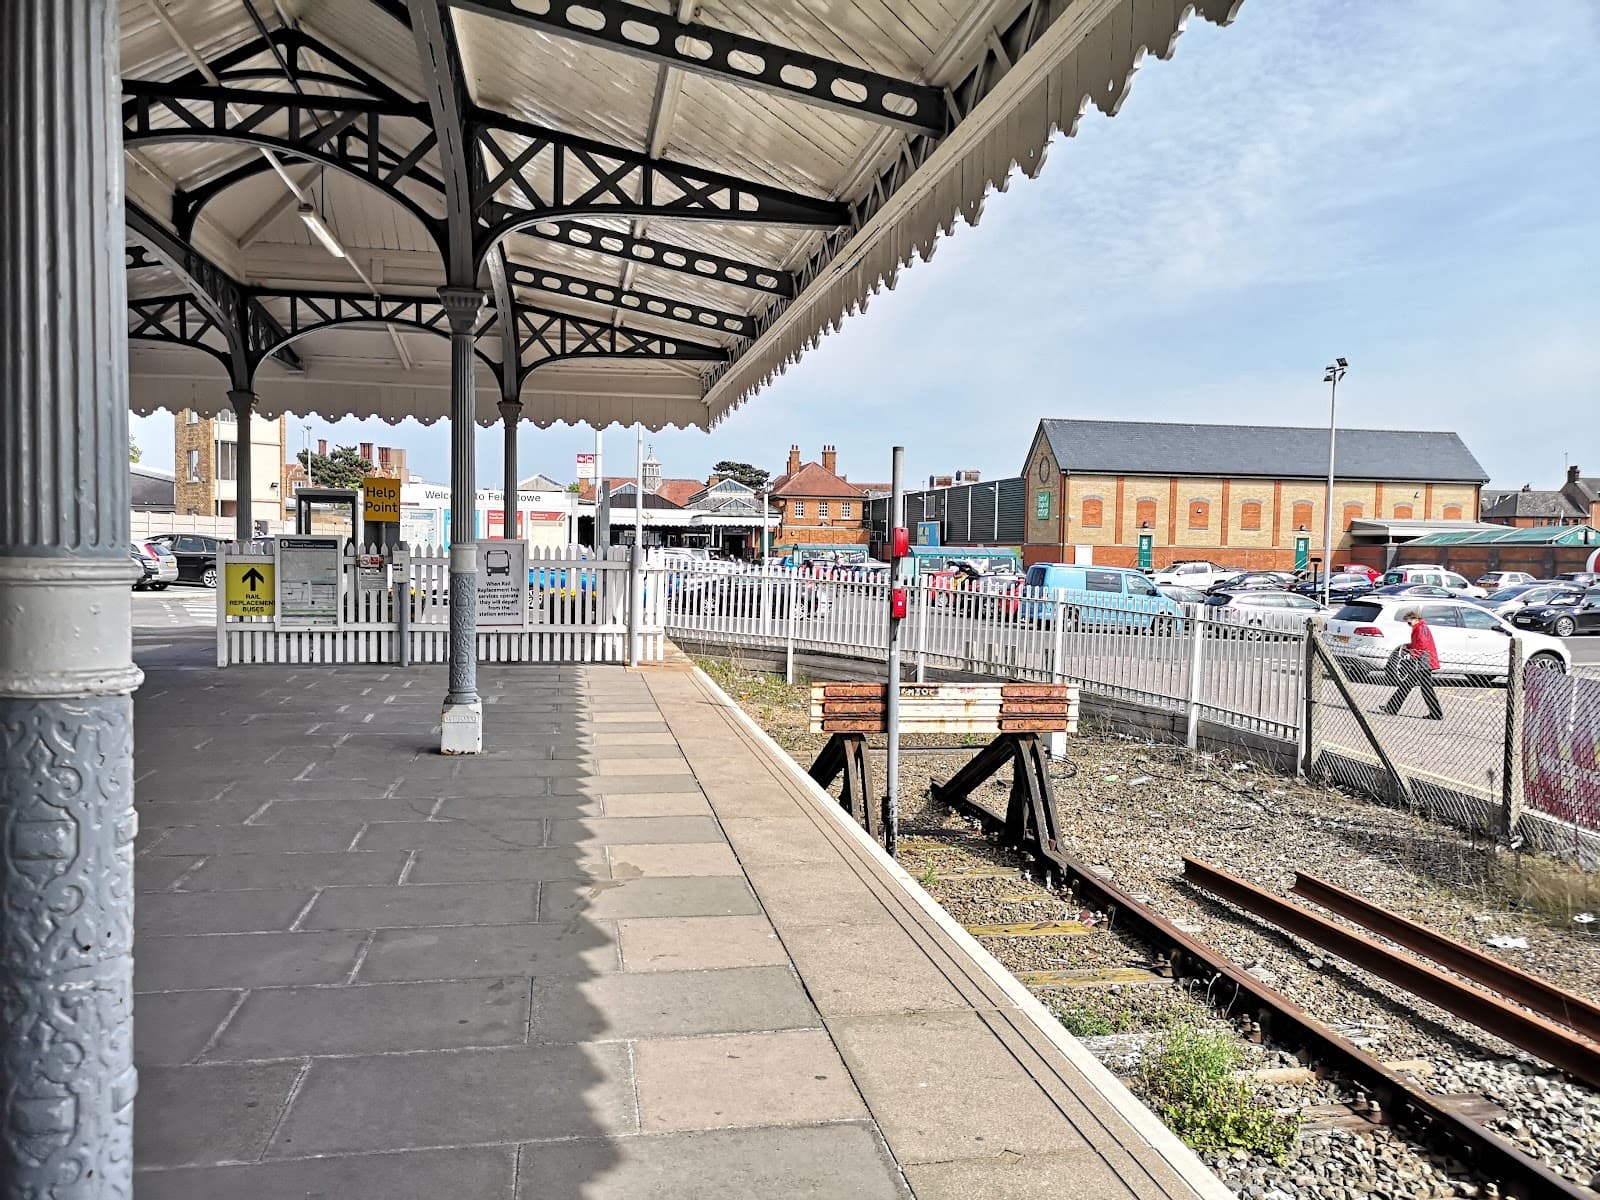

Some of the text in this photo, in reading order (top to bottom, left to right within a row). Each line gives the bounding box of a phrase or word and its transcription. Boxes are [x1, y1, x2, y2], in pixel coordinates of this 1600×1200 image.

[366, 486, 396, 500] Help
[425, 490, 449, 500] Welc
[489, 492, 541, 502] Feltowe
[365, 501, 398, 513] Point
